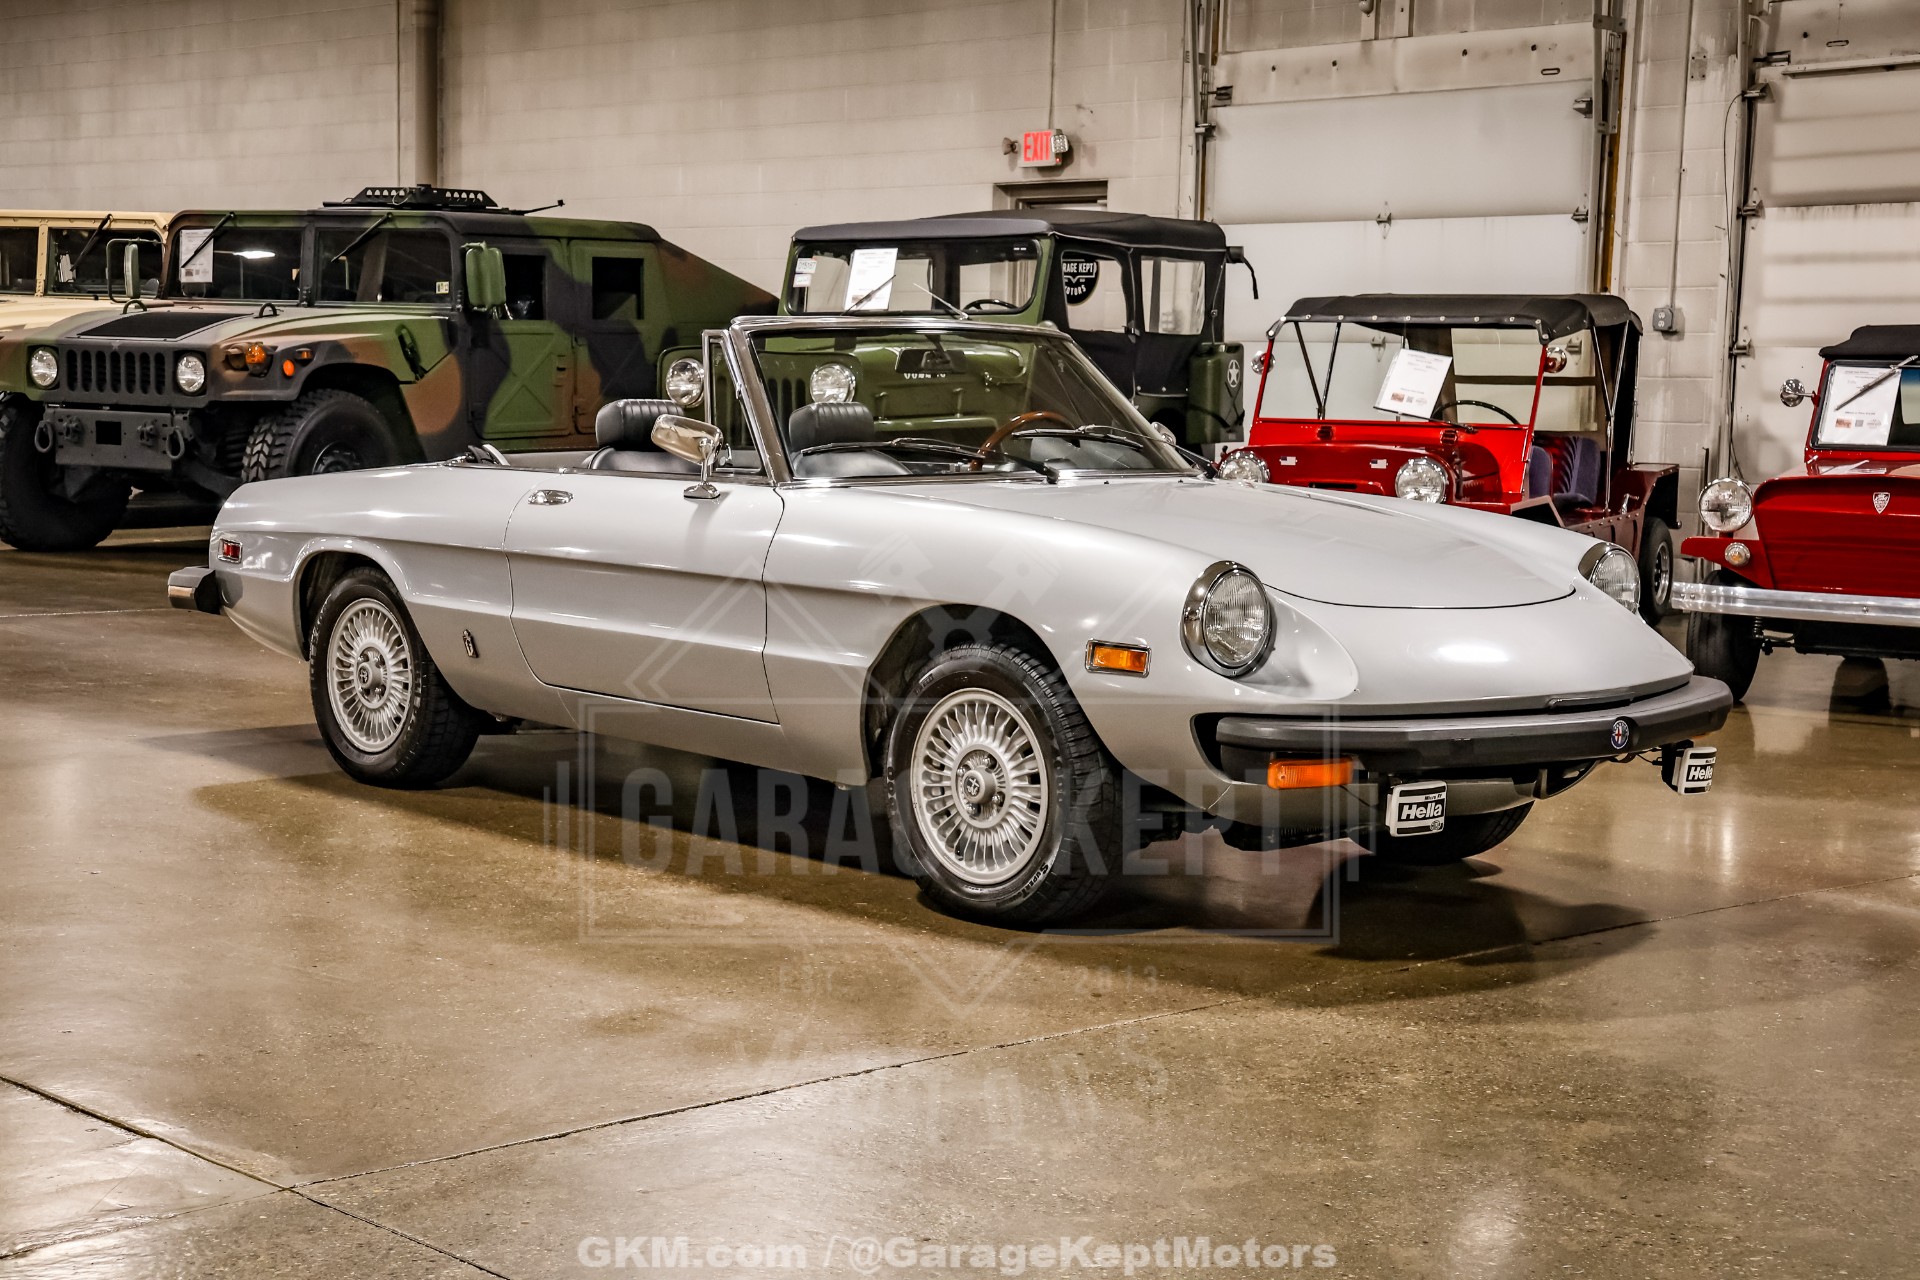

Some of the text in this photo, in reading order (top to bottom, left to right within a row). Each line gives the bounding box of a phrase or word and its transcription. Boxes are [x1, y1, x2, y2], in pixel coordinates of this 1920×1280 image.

[1023, 130, 1052, 162] EXIT
[1079, 262, 1094, 273] KEPT
[1400, 802, 1443, 820] Hella
